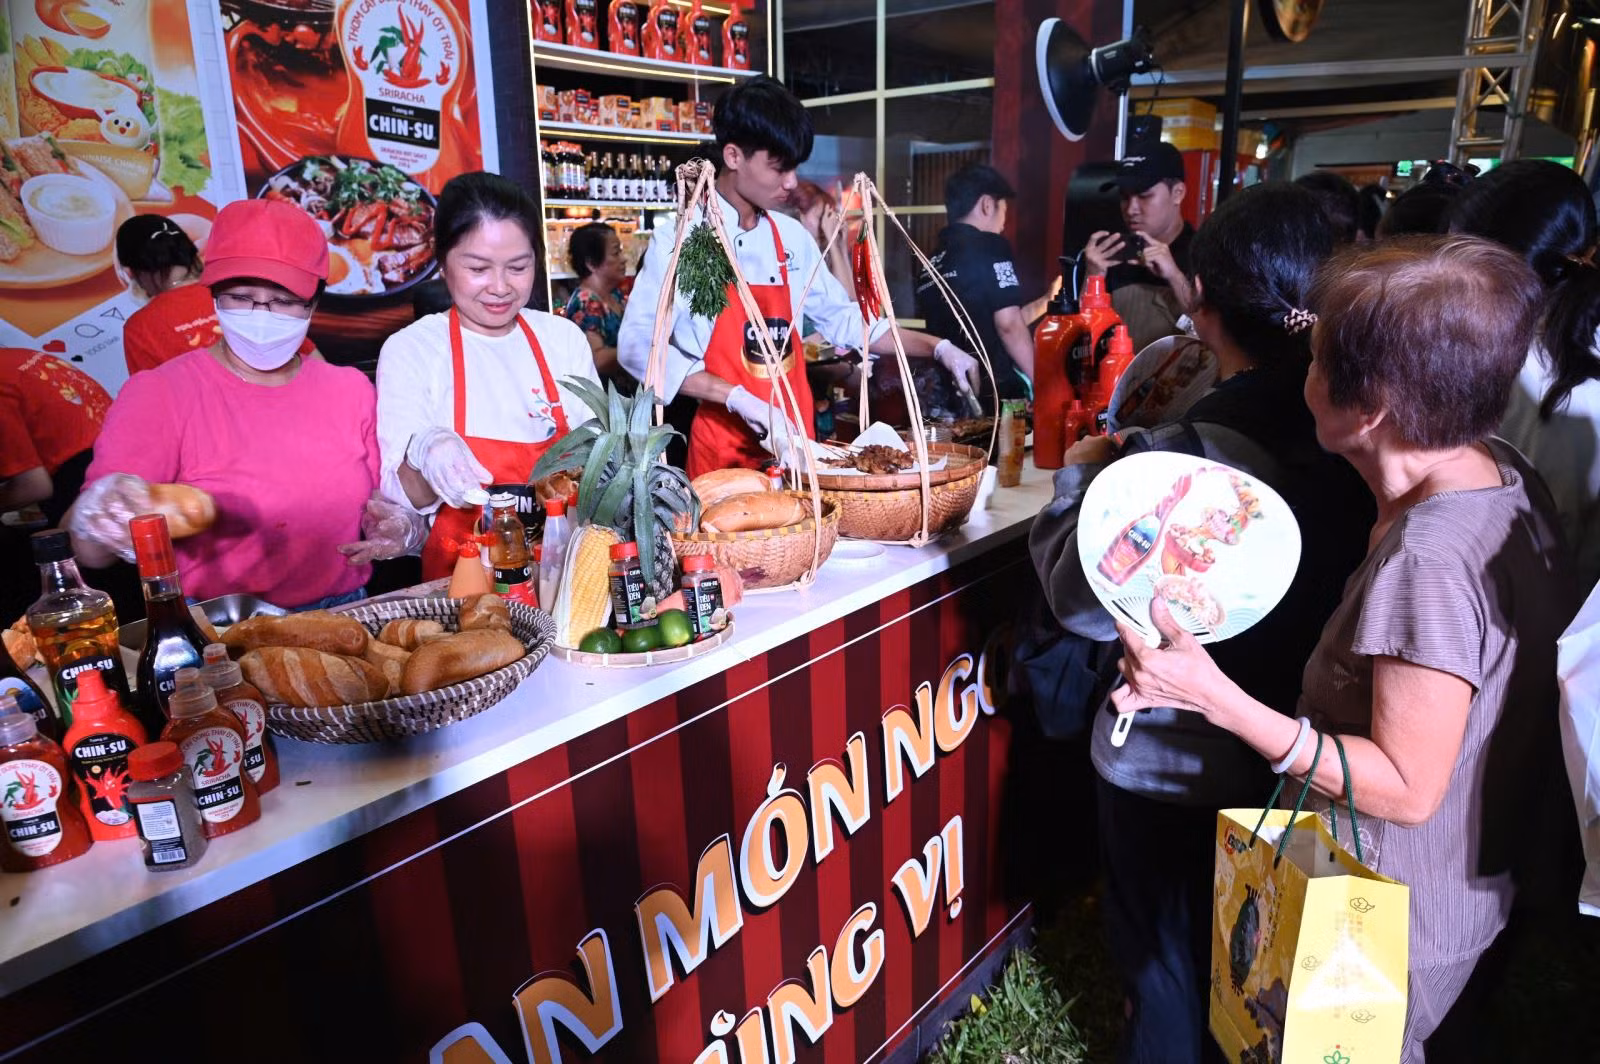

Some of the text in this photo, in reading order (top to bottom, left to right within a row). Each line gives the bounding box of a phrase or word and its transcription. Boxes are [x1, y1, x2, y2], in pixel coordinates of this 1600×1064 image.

[379, 87, 425, 104] SRIRACHA
[369, 113, 434, 141] CHIN-SU
[1128, 529, 1152, 549] CHIN-SU
[62, 658, 114, 681] CHIN-SU
[75, 739, 127, 759] CHIN-SU
[199, 785, 239, 805] CHIN-SU
[10, 820, 56, 838] CHIN-SU
[634, 730, 871, 1003] MÓN
